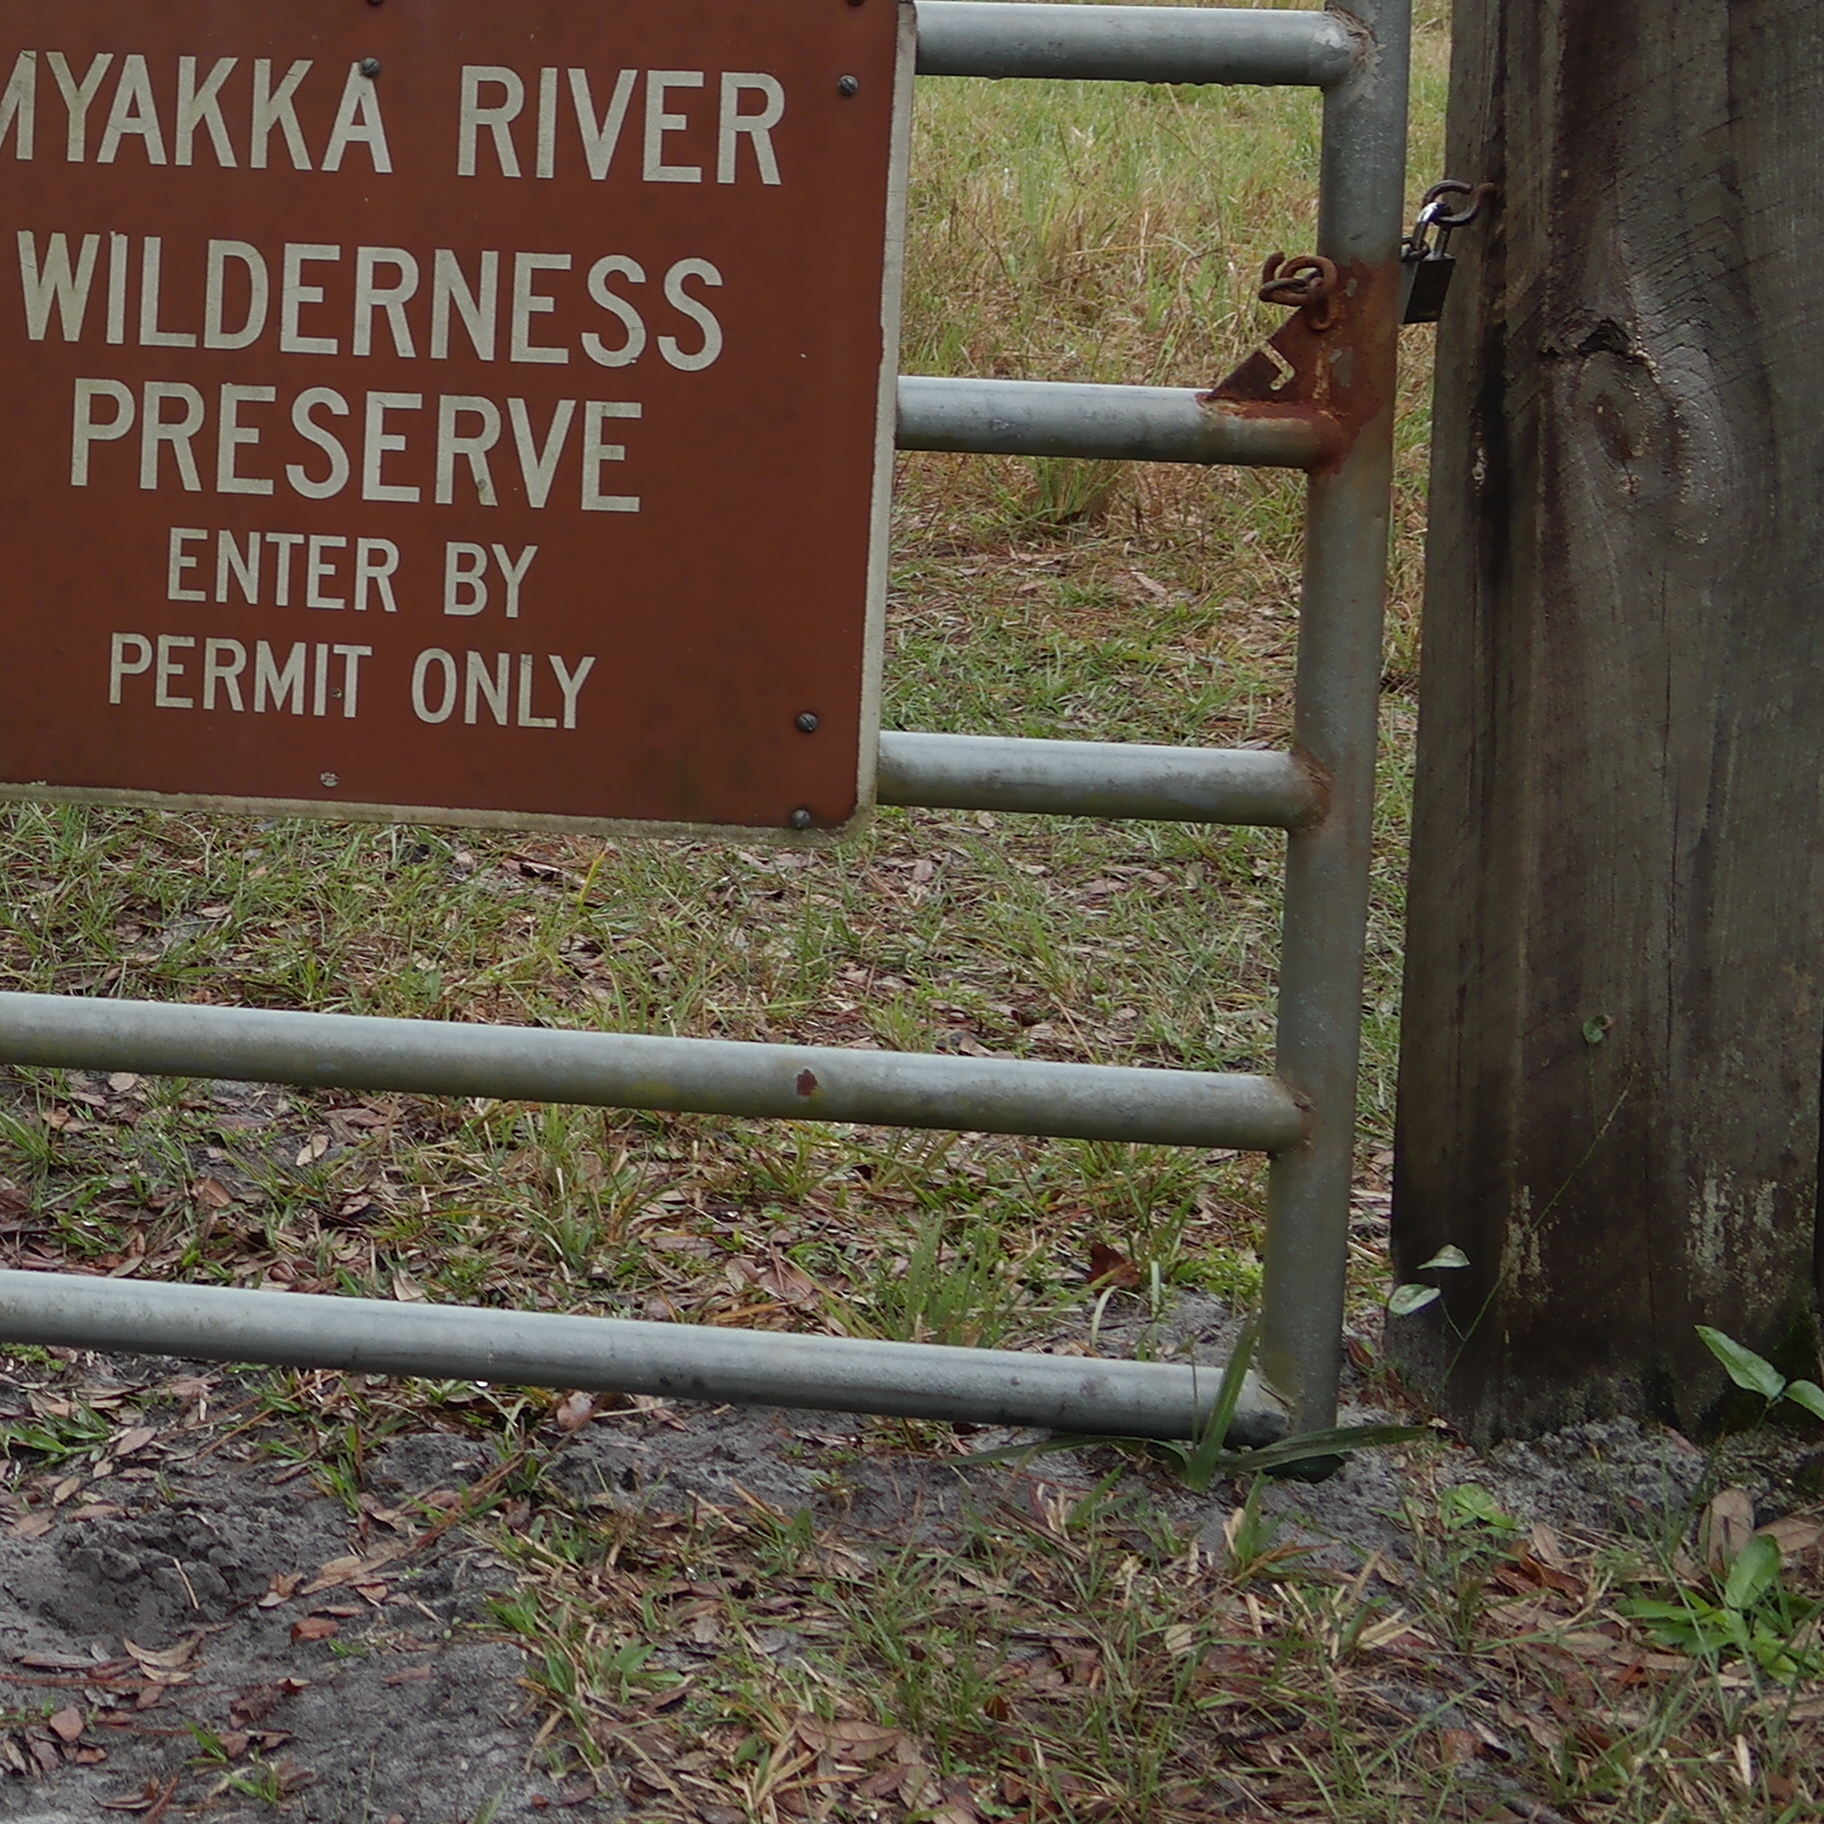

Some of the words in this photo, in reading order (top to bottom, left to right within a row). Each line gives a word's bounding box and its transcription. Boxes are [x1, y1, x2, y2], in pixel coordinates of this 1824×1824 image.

[458, 66, 784, 185] RIVER
[17, 231, 722, 371] WILDERNESS
[71, 378, 641, 512] PRESERVE
[168, 528, 399, 612] ENTER
[444, 542, 538, 617] BY
[110, 633, 372, 717] PERMIT
[412, 648, 595, 728] ONLY
